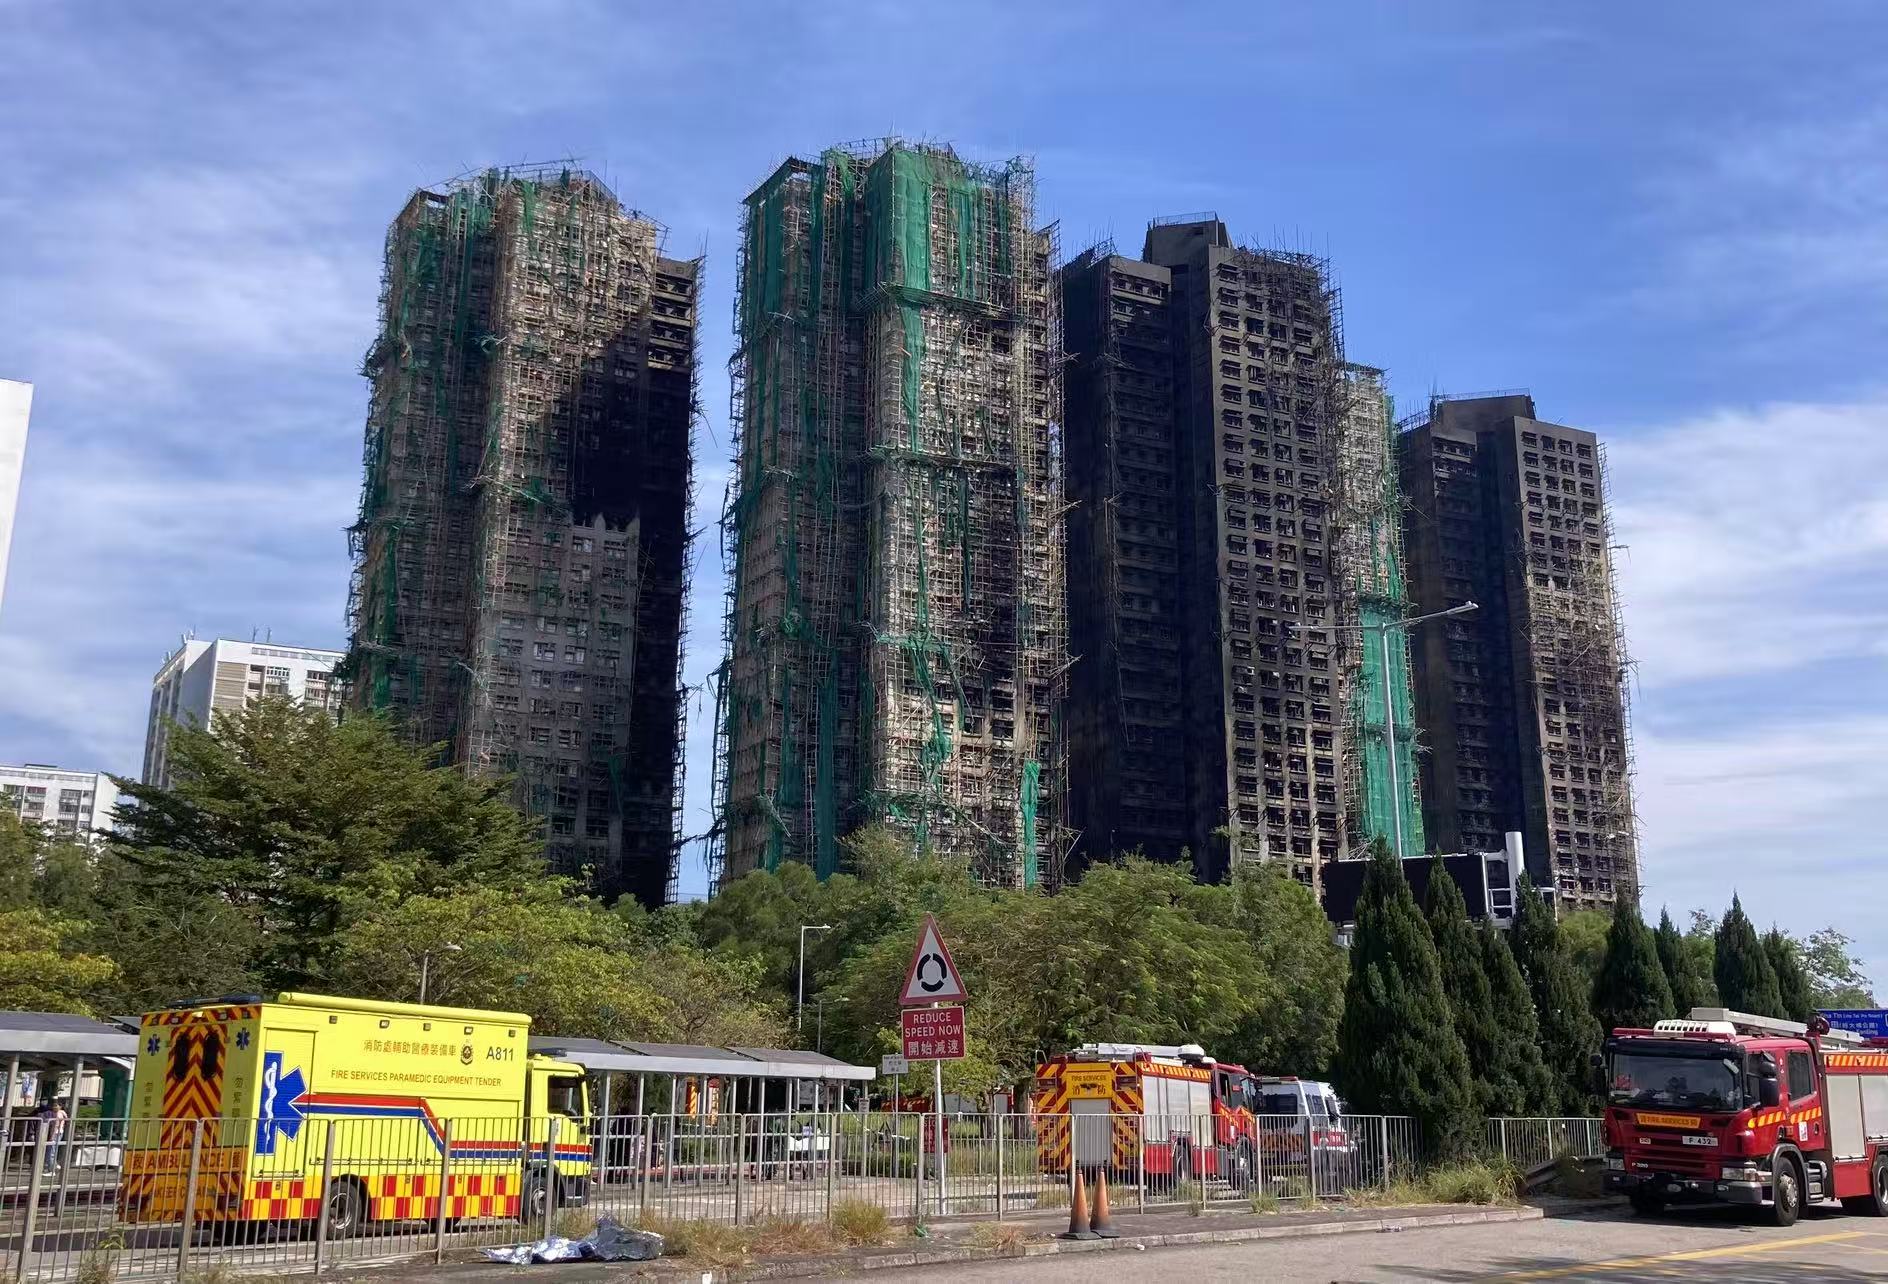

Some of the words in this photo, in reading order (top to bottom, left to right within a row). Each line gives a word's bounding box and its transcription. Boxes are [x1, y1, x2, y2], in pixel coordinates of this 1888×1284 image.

[913, 1012, 952, 1025] REDUCE
[904, 1026, 936, 1038] SPEED
[938, 1024, 961, 1036] NOW
[485, 1046, 514, 1062] A811
[908, 1039, 960, 1056] 開始減速
[331, 1069, 350, 1080] FIRE
[350, 1070, 388, 1081] SERVICES
[389, 1072, 432, 1084] PARAMEDIC
[433, 1074, 474, 1085] EQUIPMENT
[475, 1076, 502, 1087] TENDER
[147, 1151, 226, 1170] AMBULNCE
